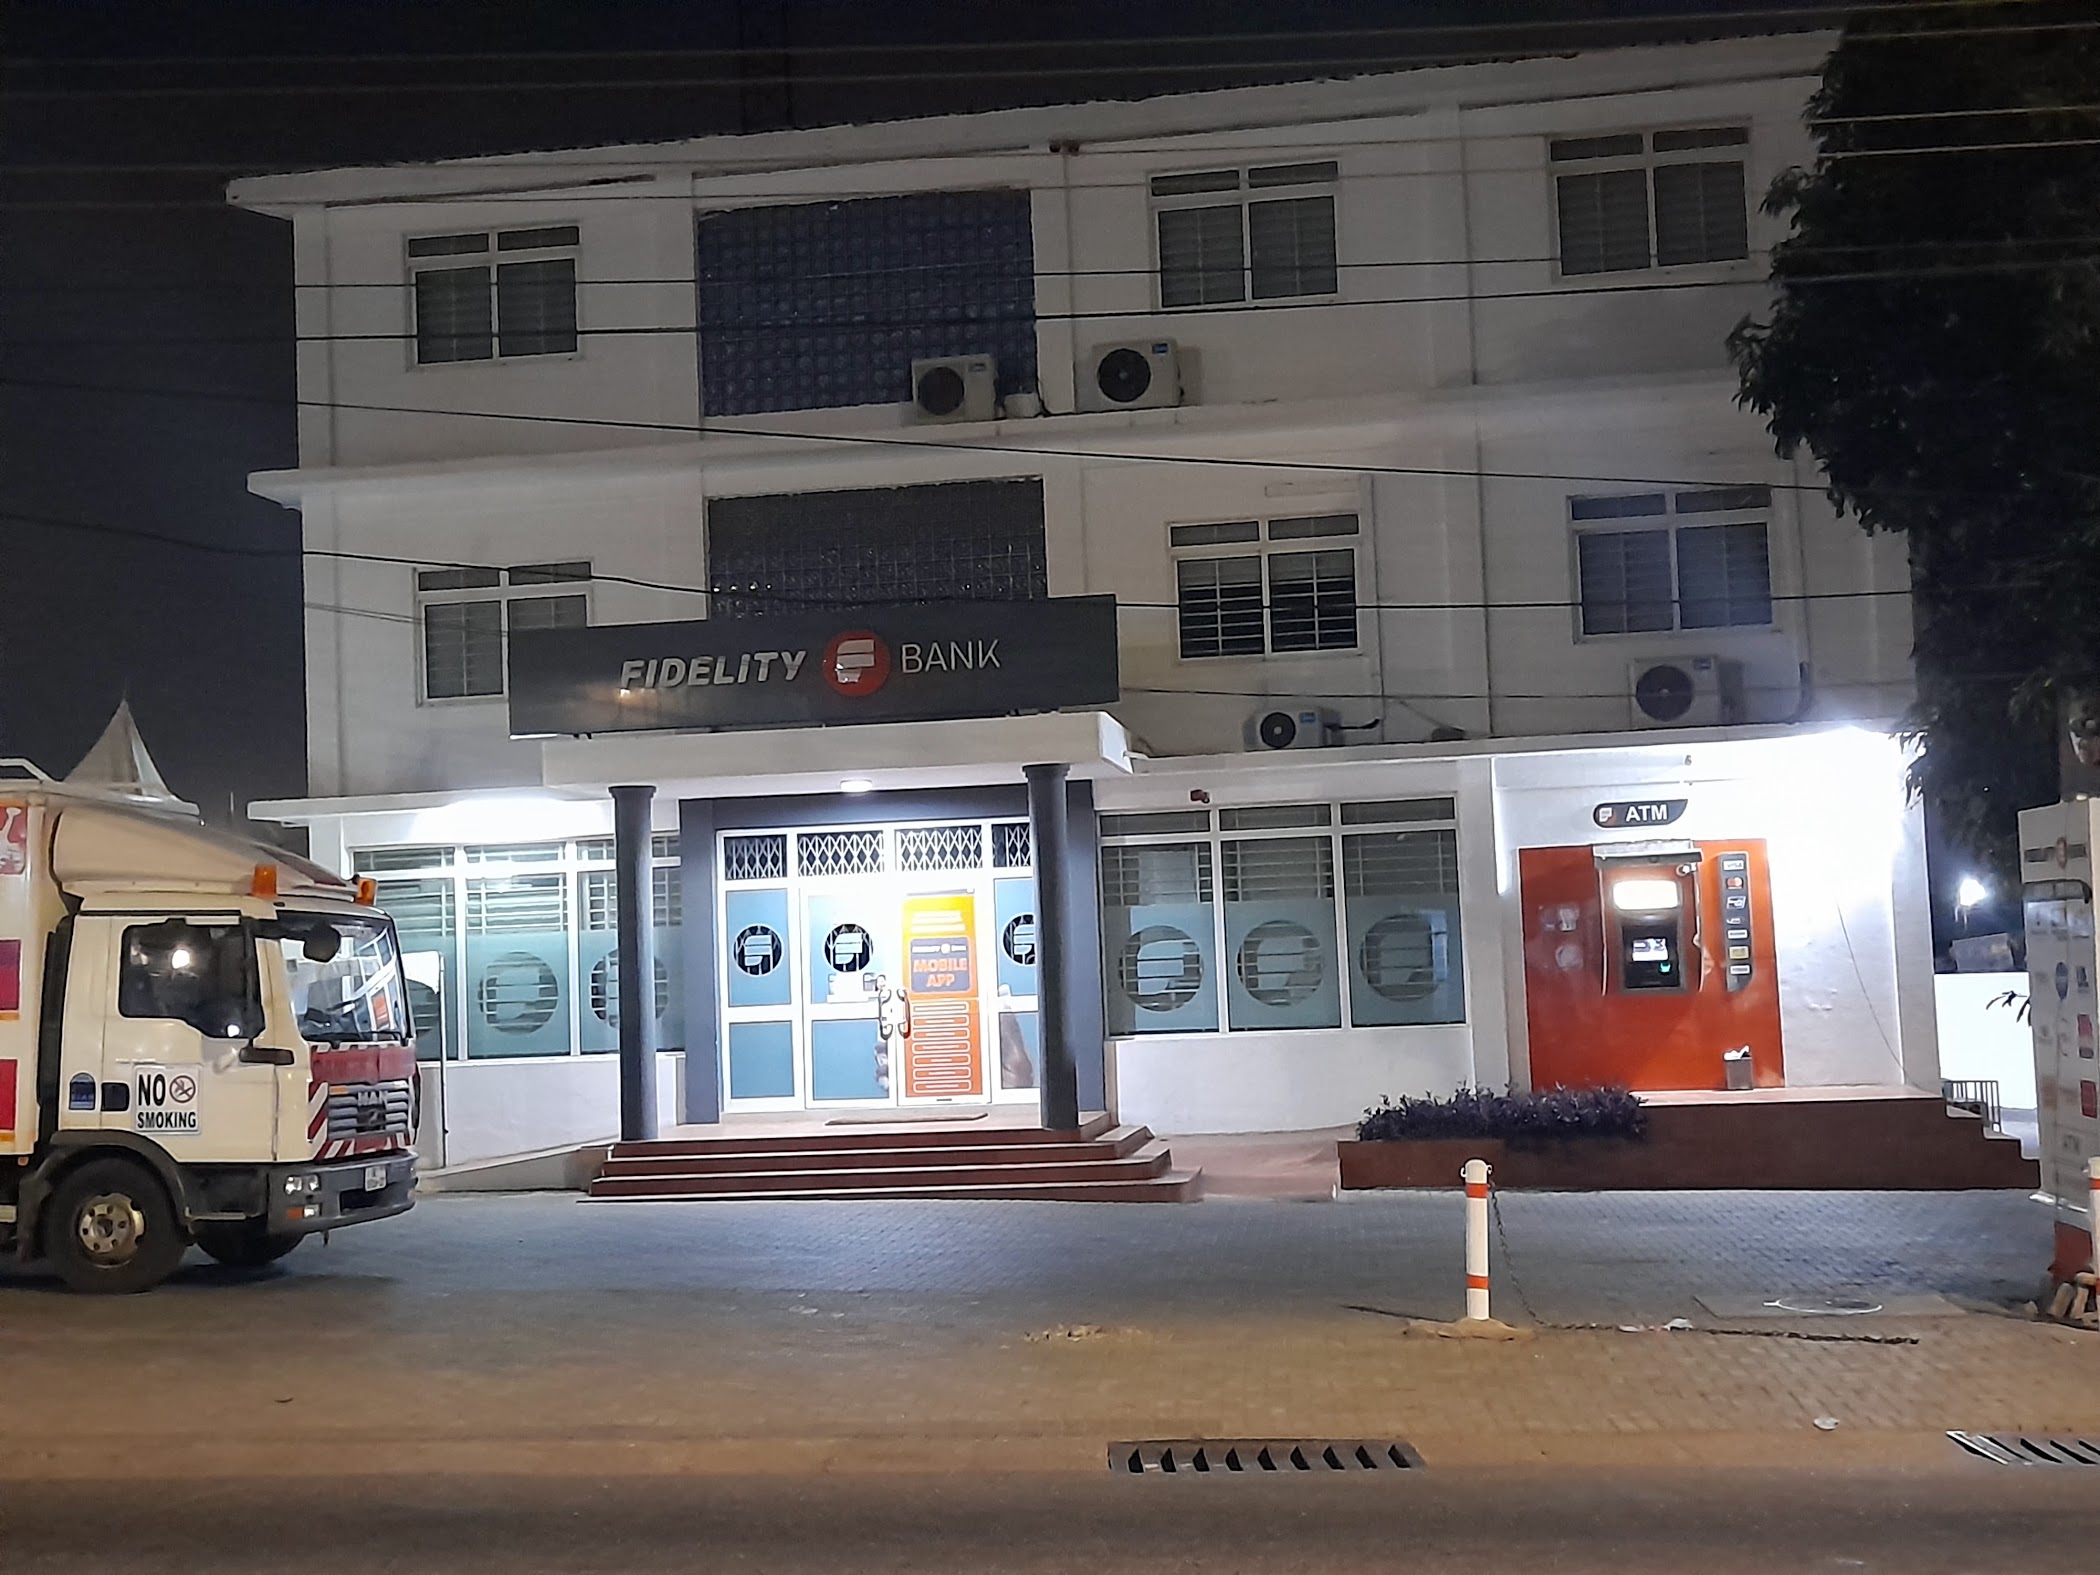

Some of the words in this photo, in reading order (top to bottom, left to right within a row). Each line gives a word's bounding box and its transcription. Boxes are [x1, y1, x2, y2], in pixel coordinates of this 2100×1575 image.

[620, 651, 806, 688] FIDELITY
[901, 639, 1000, 673] BANK
[1625, 804, 1668, 822] ATM
[912, 957, 968, 973] MOBILE
[925, 973, 955, 987] APP
[138, 1073, 166, 1107] NO
[137, 1111, 197, 1129] SMOKING
